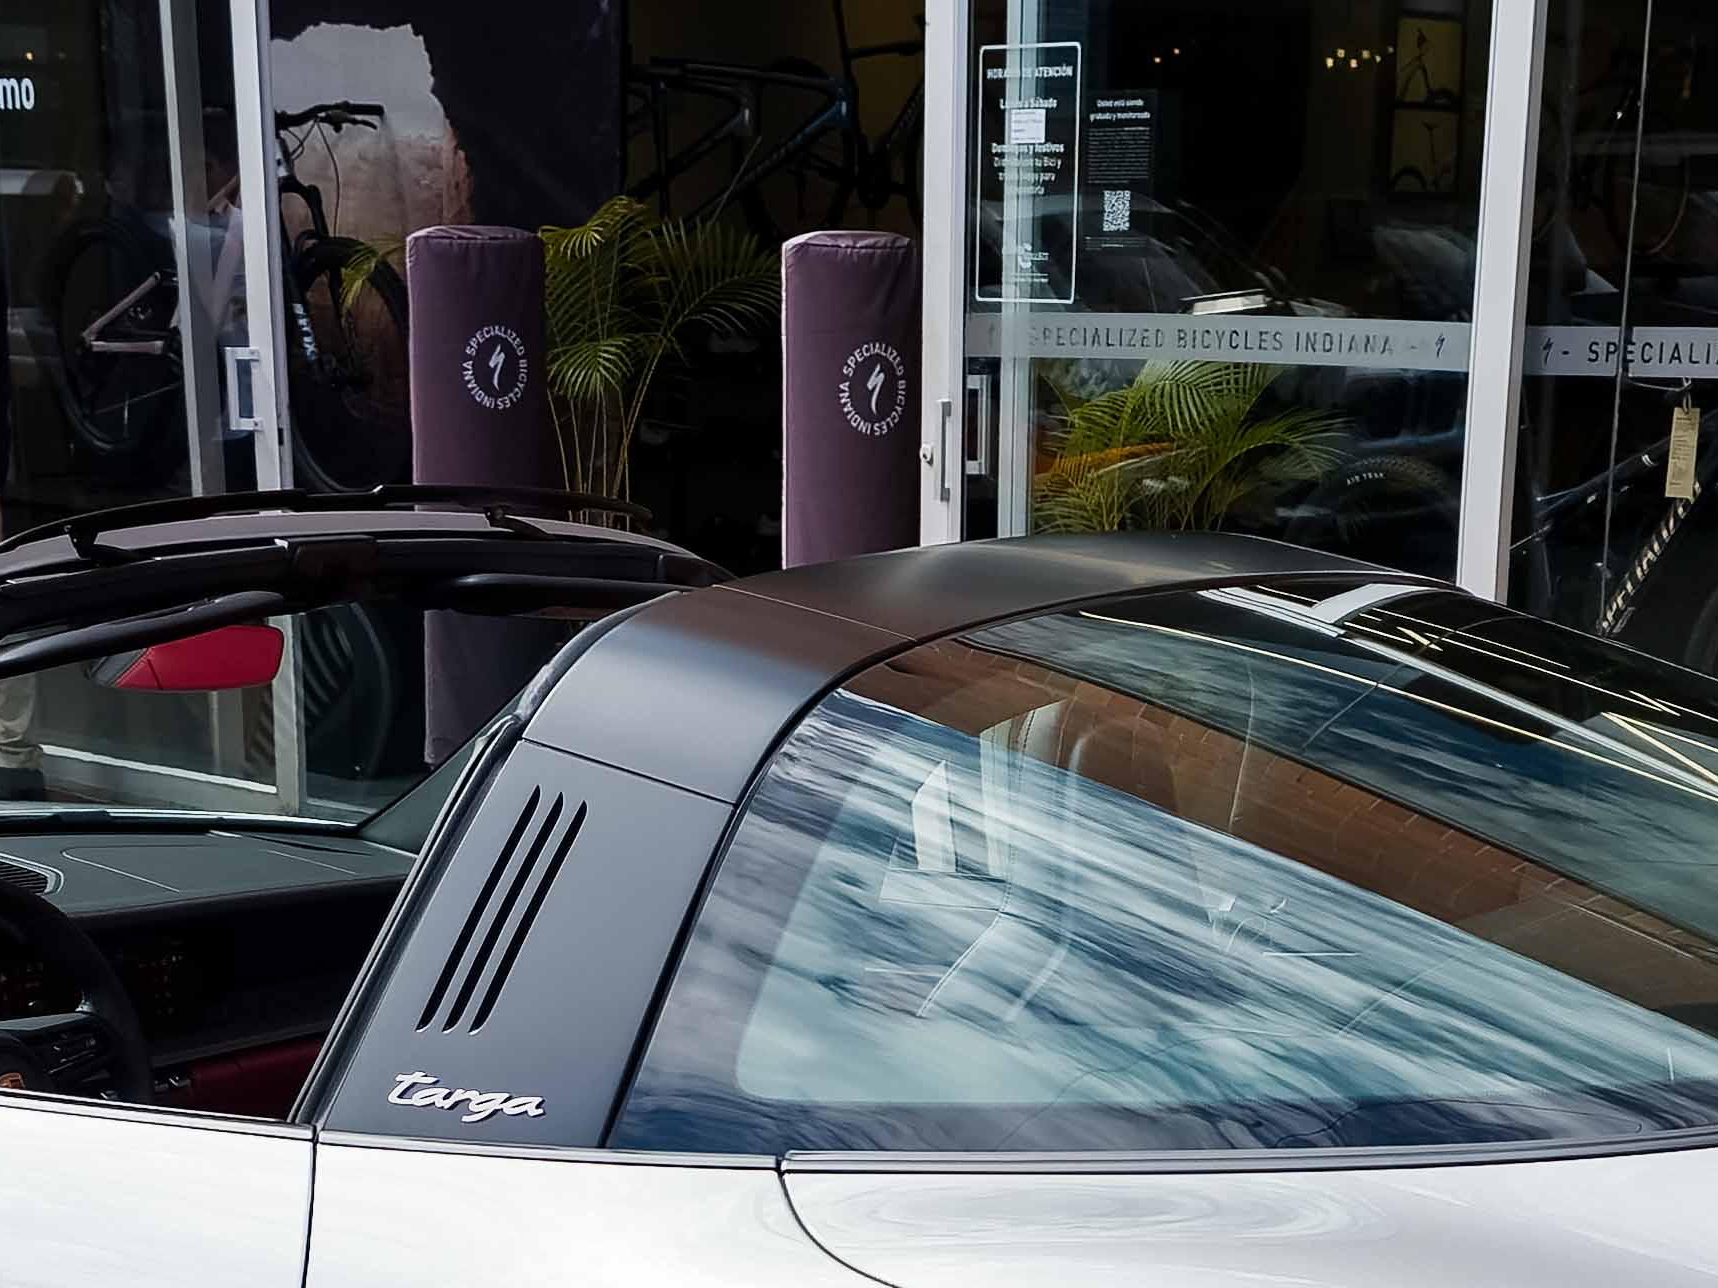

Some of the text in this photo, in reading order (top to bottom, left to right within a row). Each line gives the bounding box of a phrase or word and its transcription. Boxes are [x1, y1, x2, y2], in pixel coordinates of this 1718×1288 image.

[1177, 328, 1283, 352] BICYCLES
[1295, 332, 1395, 355] INDIANA
[387, 1071, 547, 1123] targa
